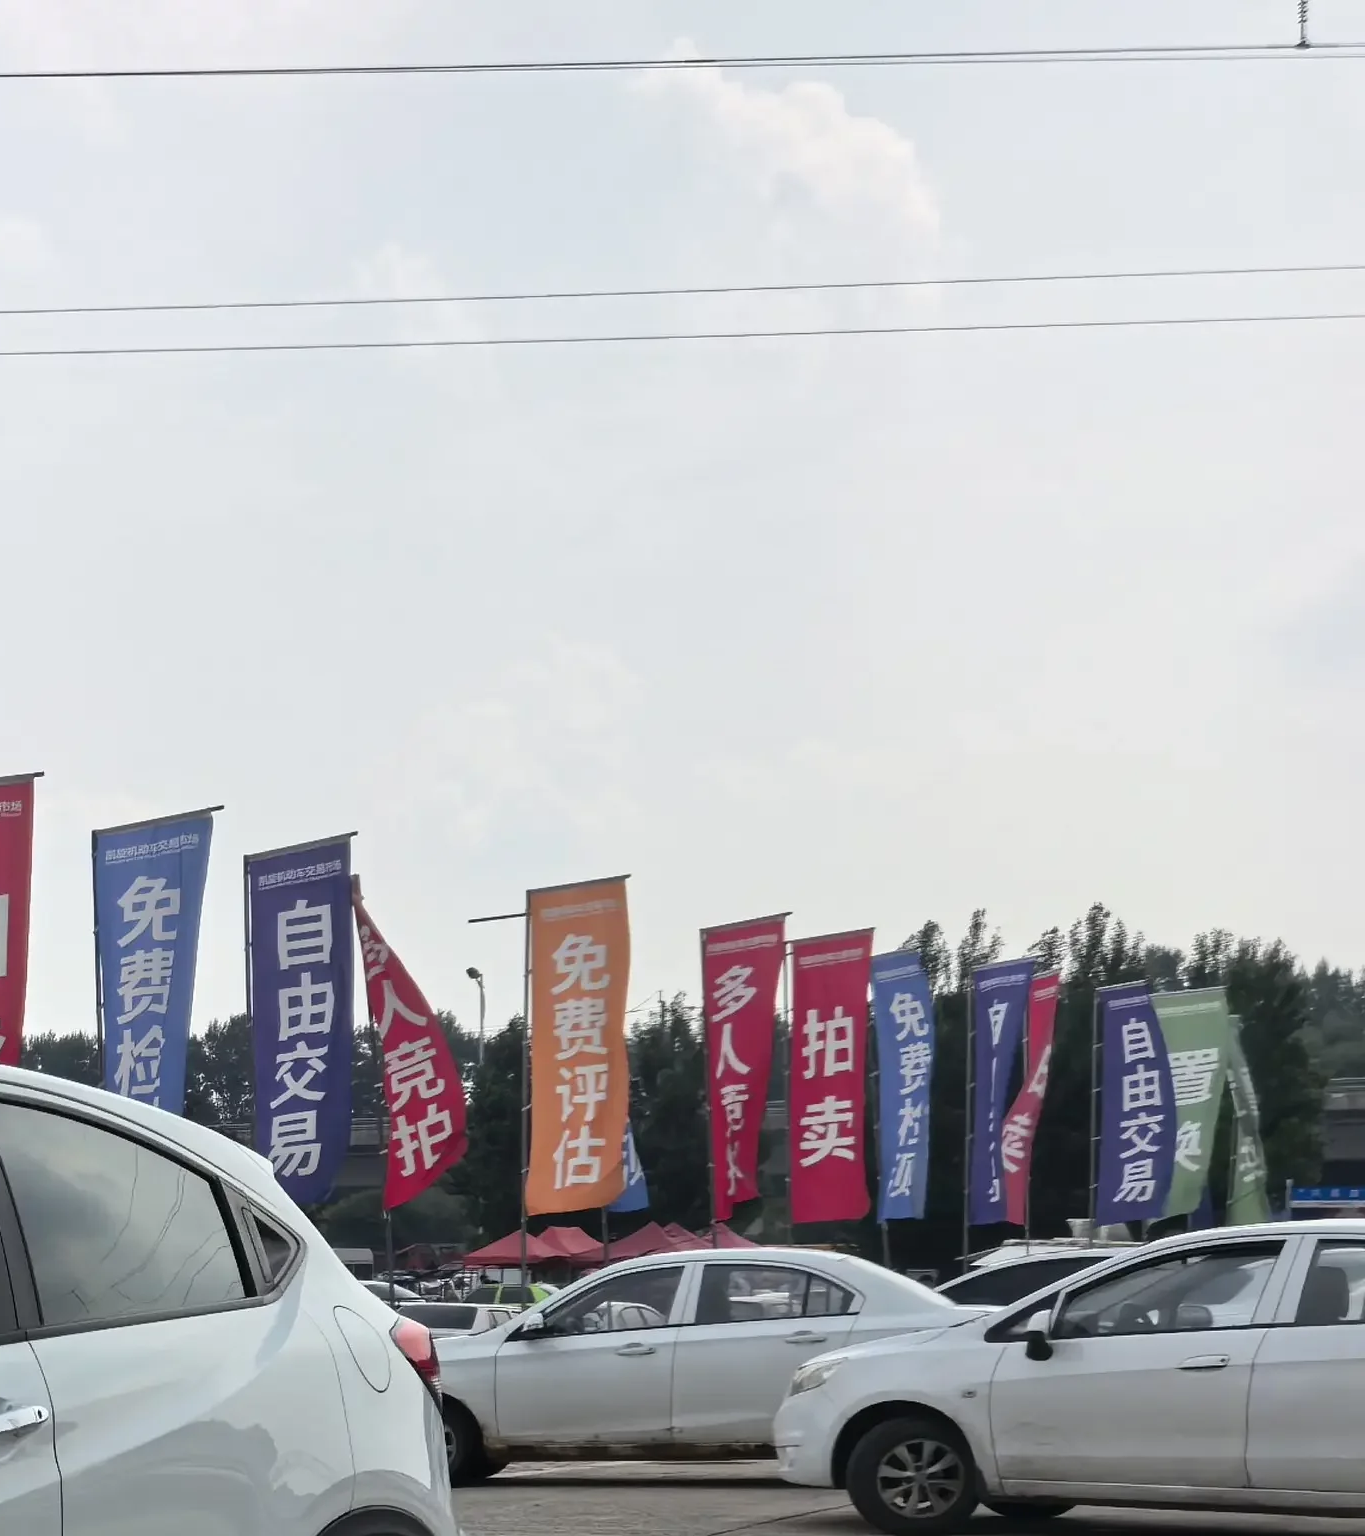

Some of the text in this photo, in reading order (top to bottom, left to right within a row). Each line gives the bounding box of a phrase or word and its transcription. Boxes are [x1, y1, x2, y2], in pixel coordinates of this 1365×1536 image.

[114, 876, 181, 1110] 免费检
[268, 899, 335, 1178] 自由交易
[550, 933, 611, 1191] 免费评估
[799, 1005, 856, 1168] 拍卖
[1113, 1017, 1166, 1203] 自由交易
